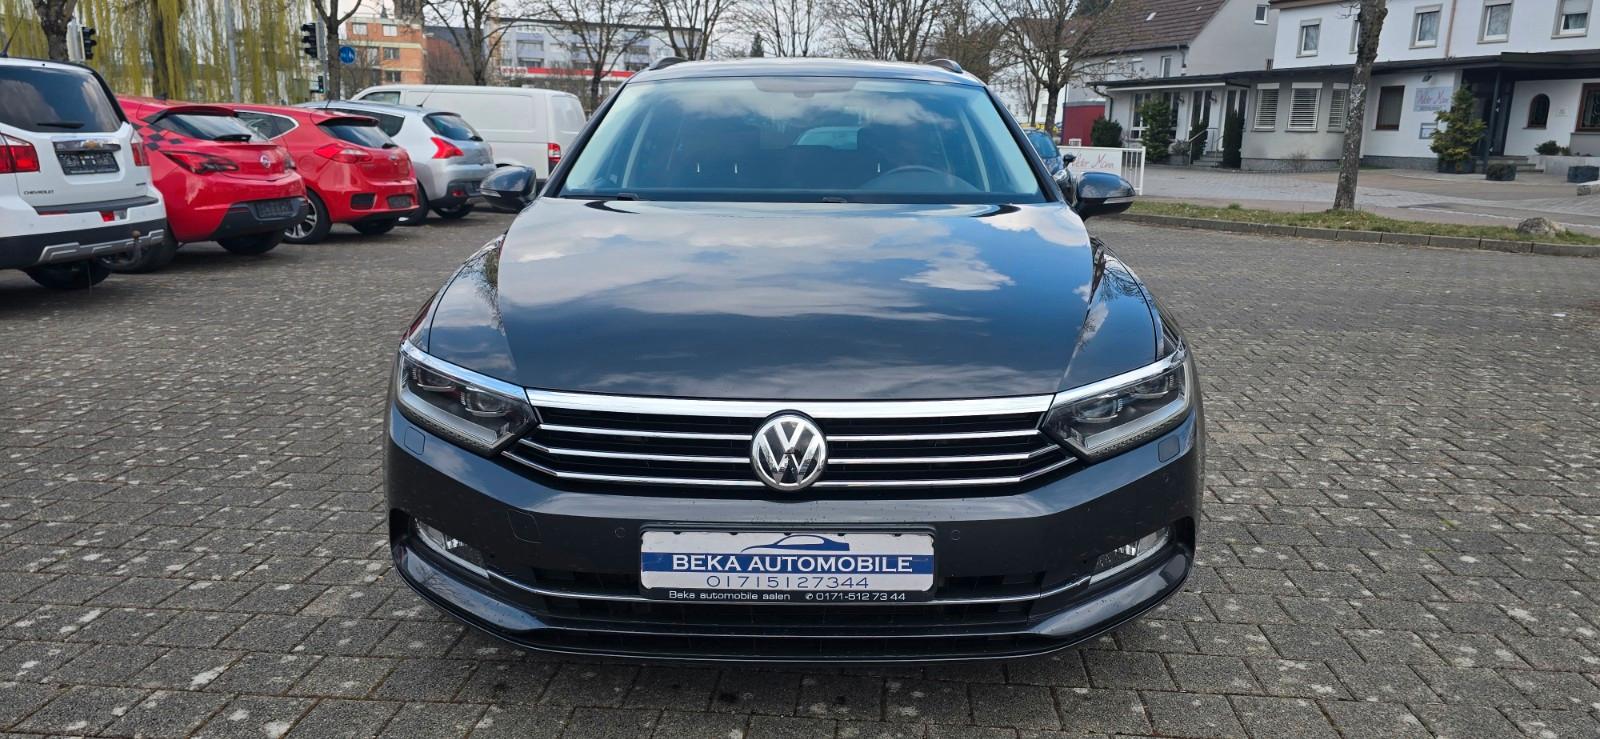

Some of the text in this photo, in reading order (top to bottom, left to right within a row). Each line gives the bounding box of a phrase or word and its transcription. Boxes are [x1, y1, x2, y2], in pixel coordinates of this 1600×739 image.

[672, 554, 913, 573] BEKA AUTOMOBILE
[706, 575, 869, 589] 01715127344
[669, 590, 695, 599] Beka
[699, 591, 758, 600] automobile
[763, 591, 791, 601] aalen
[815, 592, 871, 601] 0171-512
